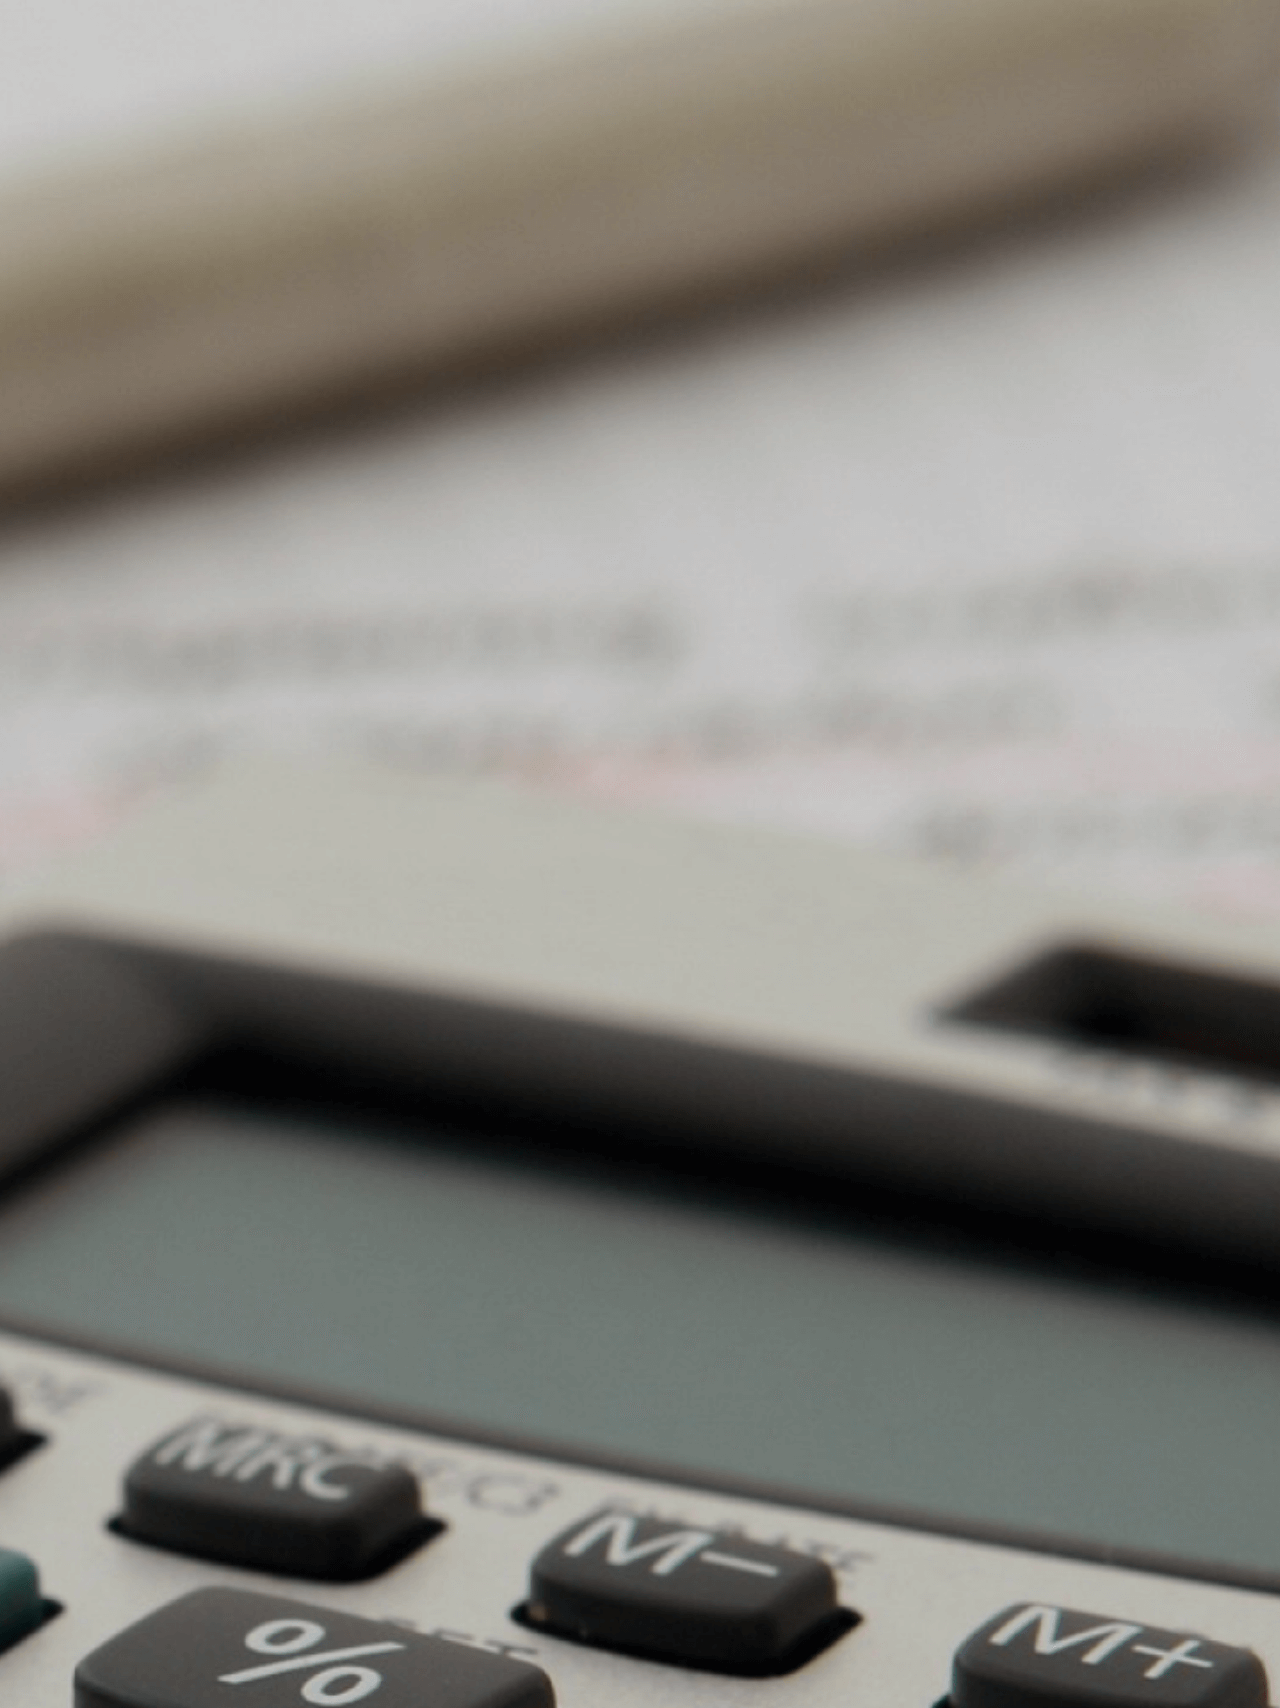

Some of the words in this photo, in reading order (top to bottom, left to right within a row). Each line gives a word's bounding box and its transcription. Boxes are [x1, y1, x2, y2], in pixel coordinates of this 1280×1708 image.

[154, 1421, 377, 1500] MRC
[564, 1515, 778, 1577] M-
[218, 1618, 407, 1706] %
[991, 1604, 1214, 1681] M+
